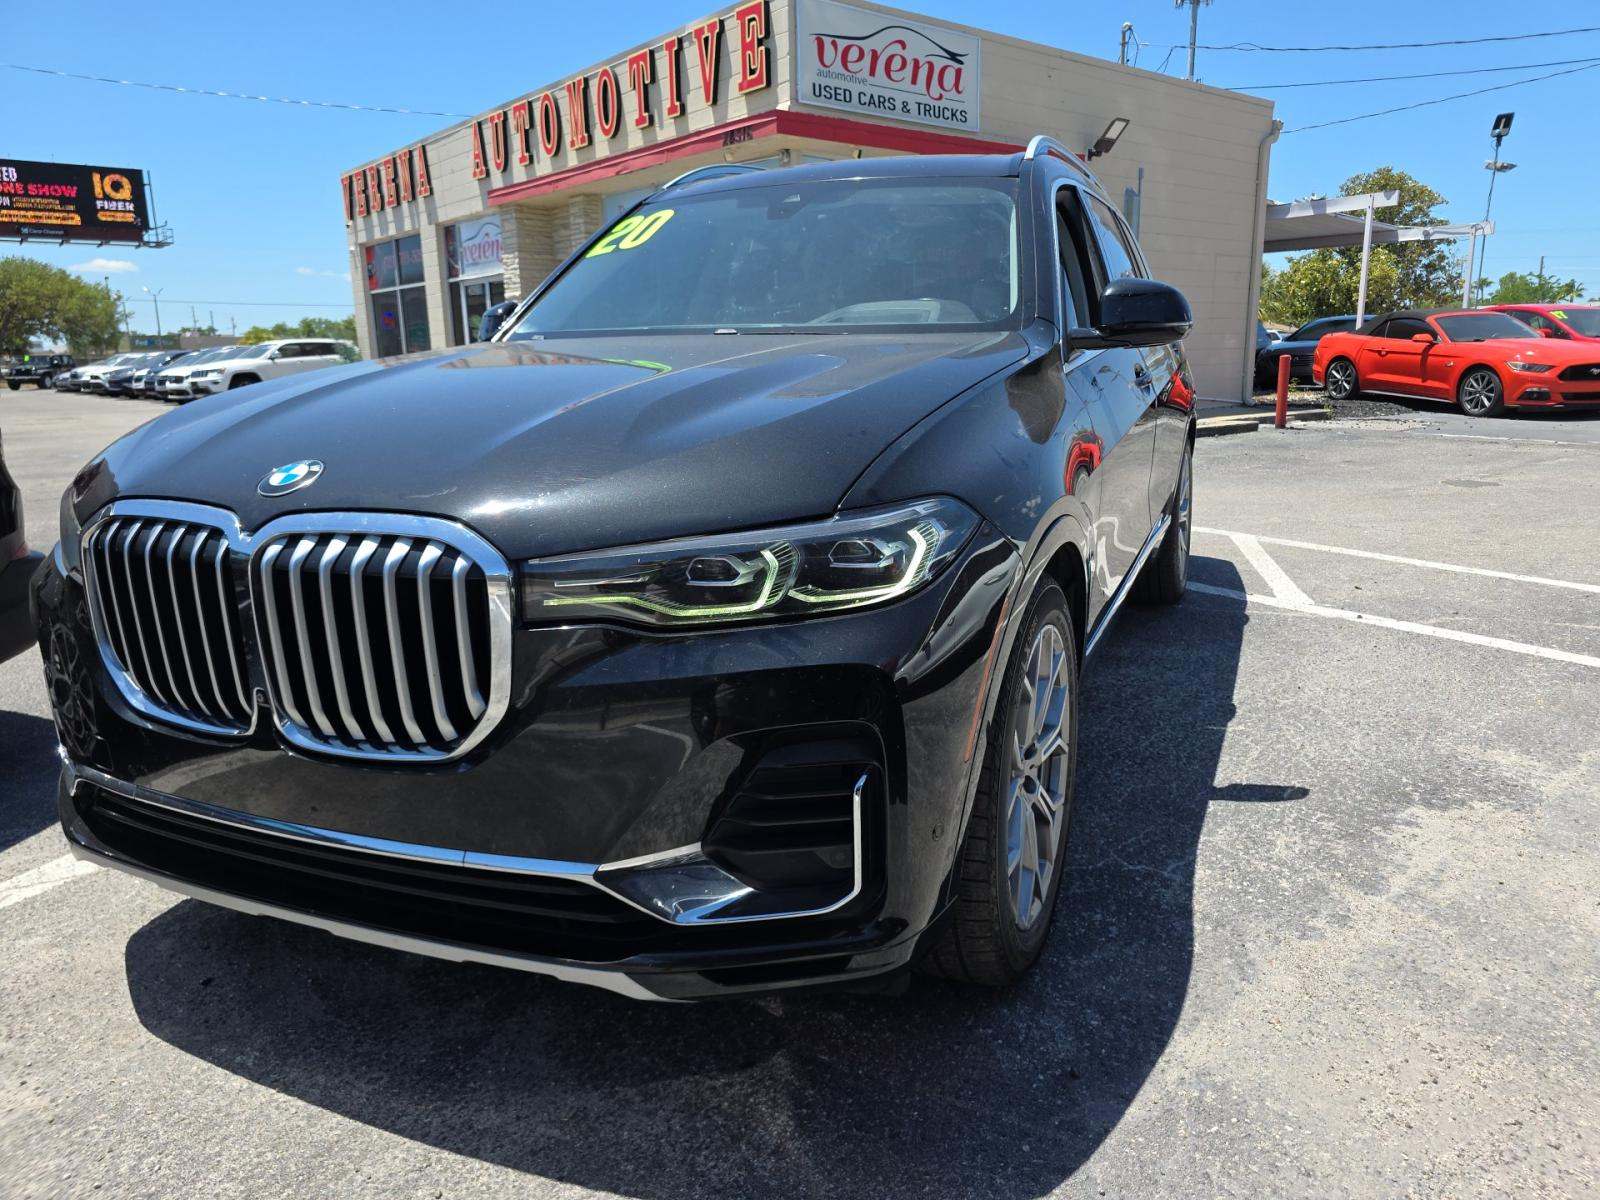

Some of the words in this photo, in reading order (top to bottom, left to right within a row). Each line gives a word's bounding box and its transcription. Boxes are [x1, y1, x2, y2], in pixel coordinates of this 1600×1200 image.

[813, 36, 965, 101] verena
[816, 68, 869, 87] automotive
[341, 144, 431, 220] VERENA
[472, 0, 769, 180] AUTOMOTIVE
[812, 82, 852, 103] USED
[858, 91, 896, 111] CARS
[901, 101, 912, 114] &
[915, 101, 968, 123] TRUCKS
[0, 167, 17, 181] ED
[92, 171, 133, 200] IQ
[27, 183, 78, 197] SHOW
[96, 200, 135, 211] FIBER
[585, 209, 675, 258] 20
